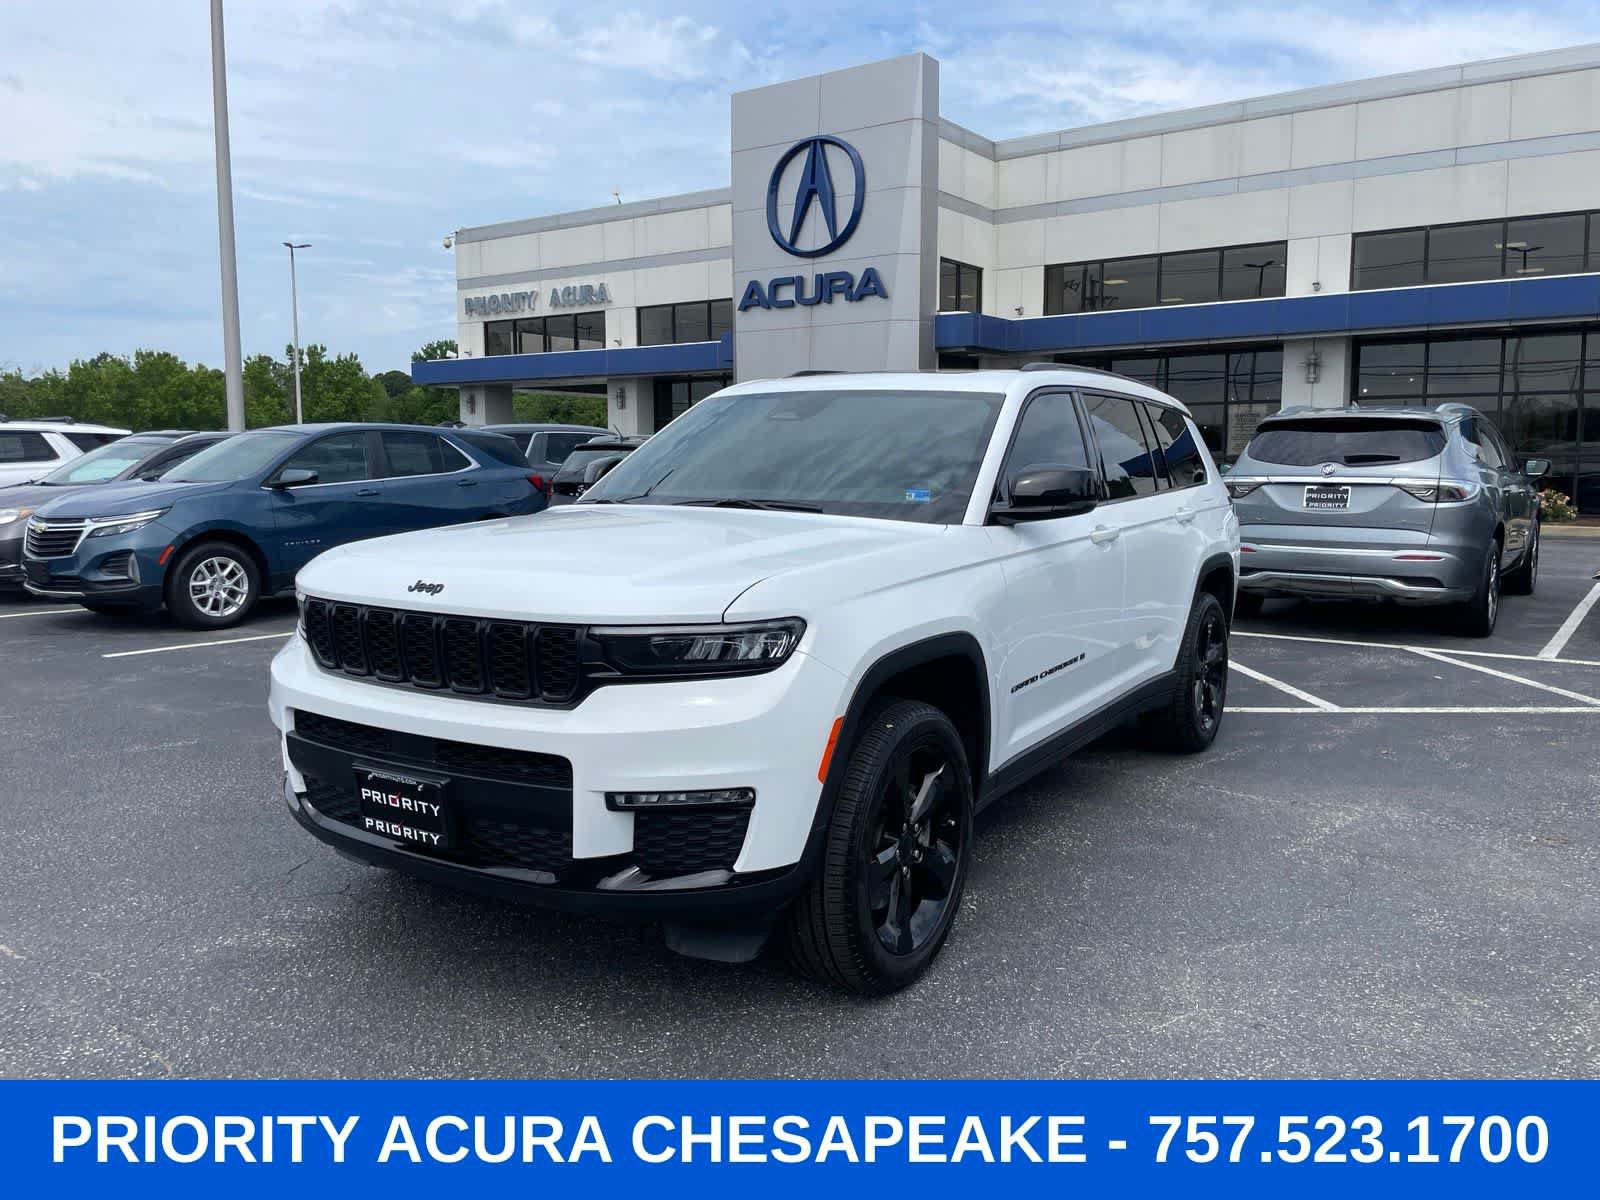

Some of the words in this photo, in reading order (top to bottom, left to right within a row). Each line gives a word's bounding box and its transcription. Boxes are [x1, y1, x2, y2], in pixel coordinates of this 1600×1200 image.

[464, 290, 538, 316] PRIORITY
[549, 283, 612, 308] ACURA
[738, 267, 888, 312] ACURA
[407, 579, 445, 596] Jeep
[1010, 675, 1039, 694] GRAND
[361, 787, 440, 817] PRIORITY
[364, 817, 440, 846] PRIORITY
